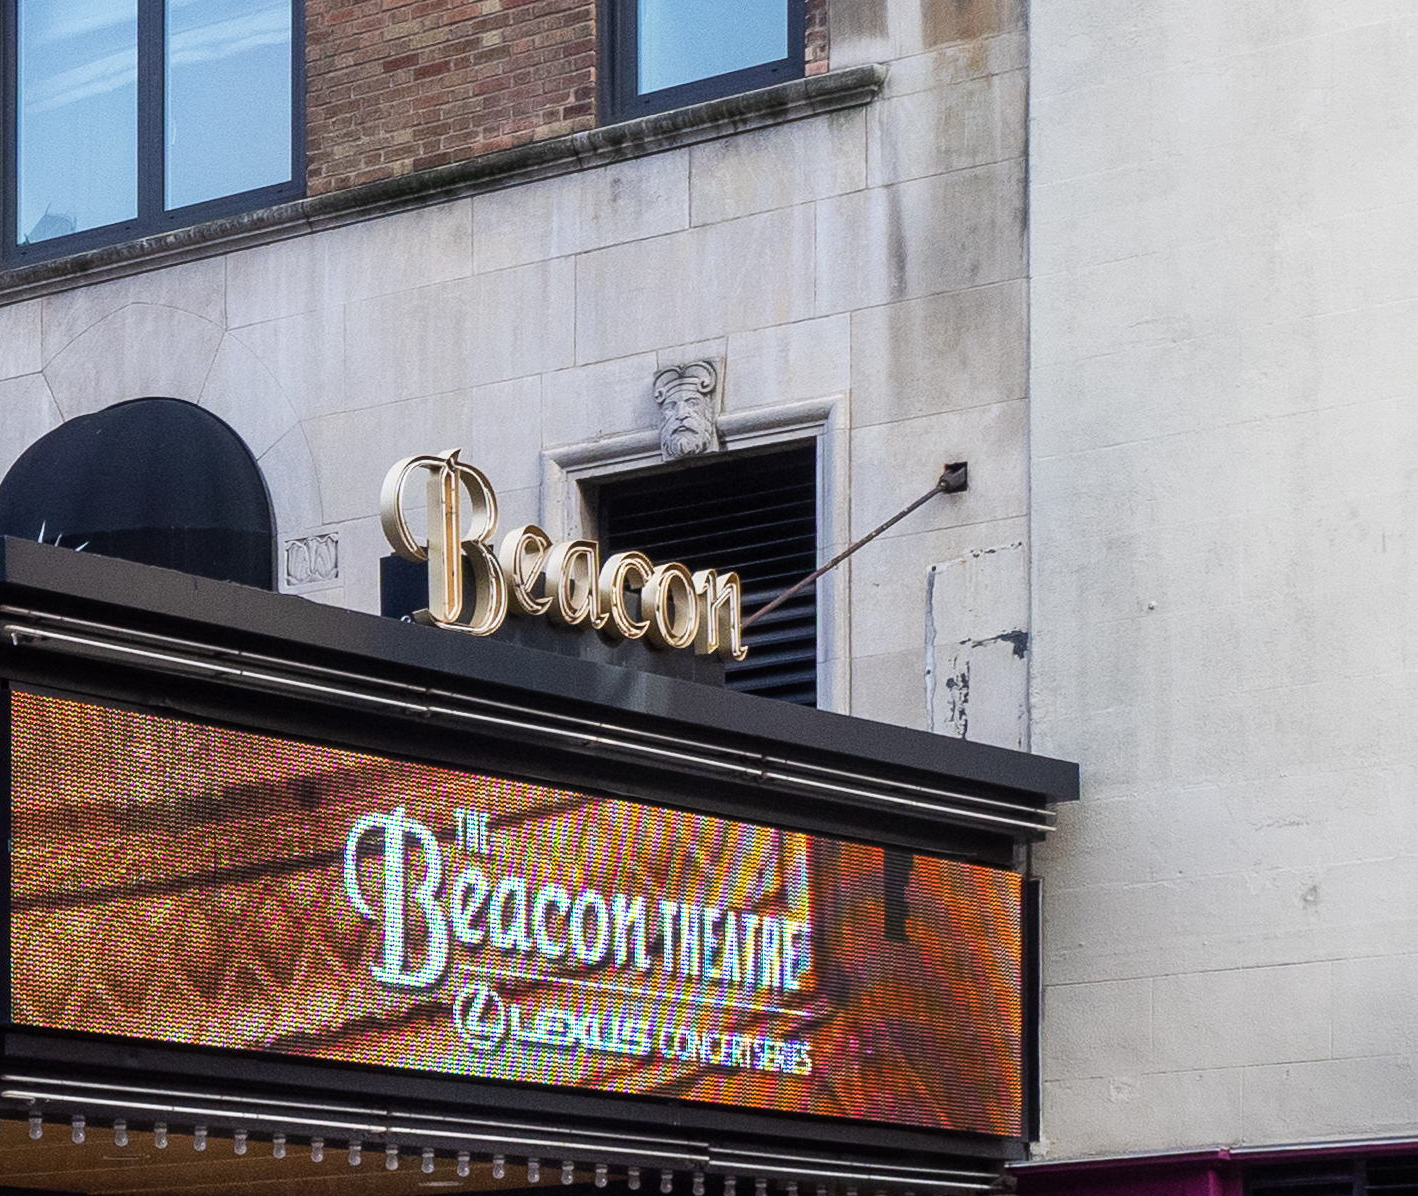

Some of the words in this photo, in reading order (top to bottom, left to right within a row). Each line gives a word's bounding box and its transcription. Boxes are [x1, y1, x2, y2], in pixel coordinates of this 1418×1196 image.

[380, 448, 748, 661] Beacon
[454, 806, 491, 853] THE
[661, 899, 804, 993] THEATRE
[509, 1002, 655, 1057] LEXUS
